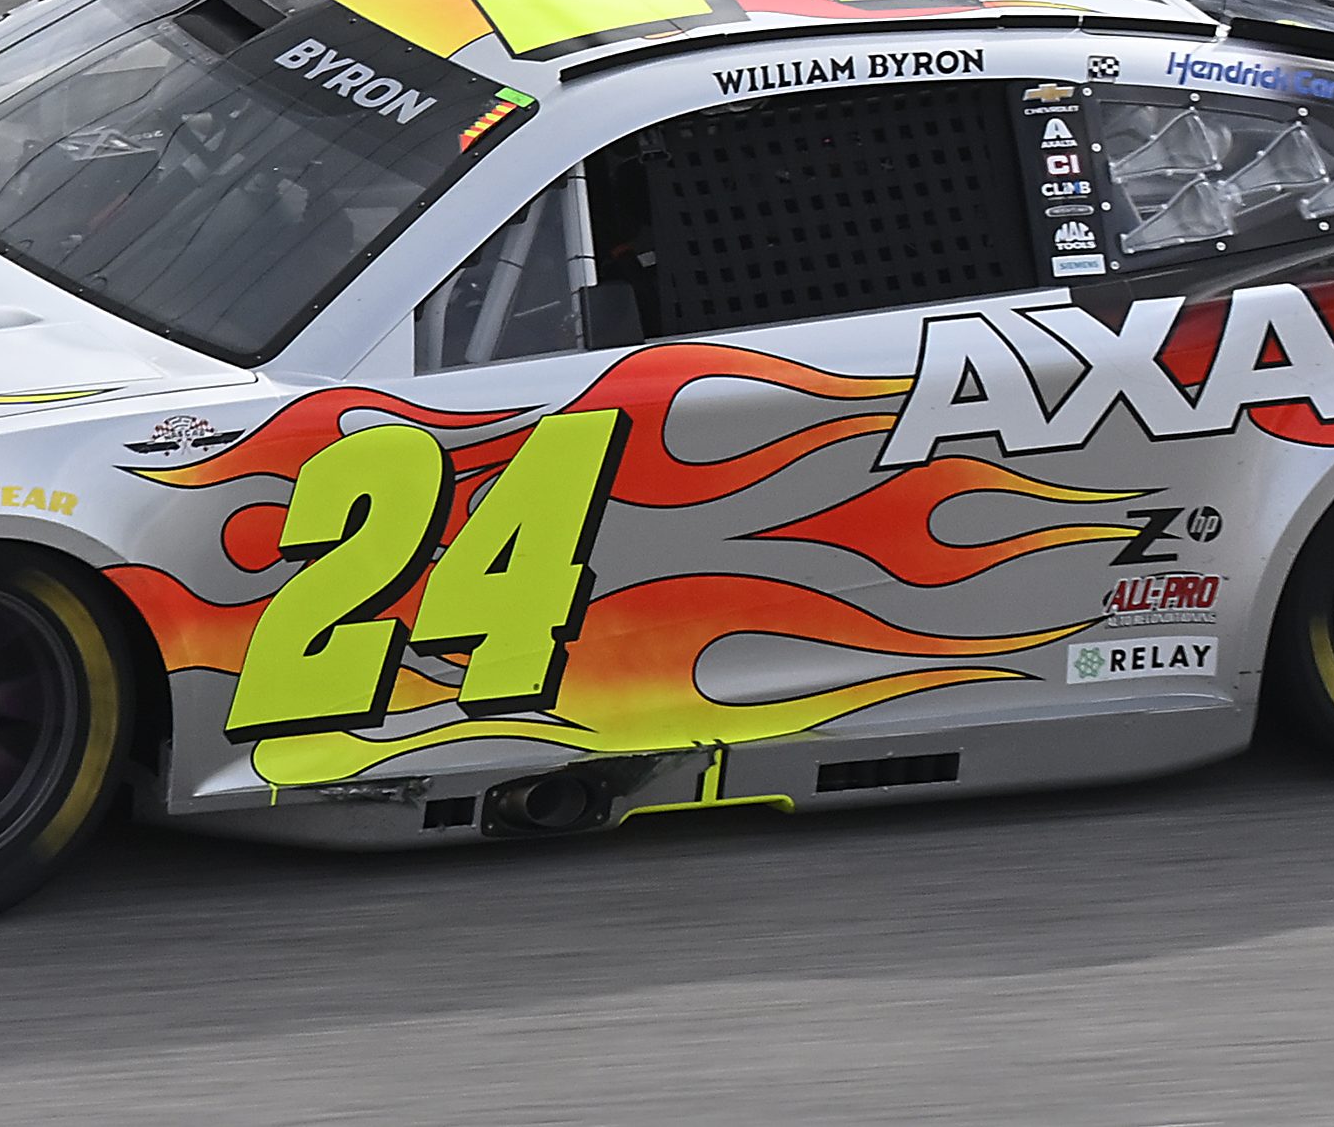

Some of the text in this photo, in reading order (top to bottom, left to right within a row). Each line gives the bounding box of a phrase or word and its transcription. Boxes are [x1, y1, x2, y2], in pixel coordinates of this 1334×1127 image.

[273, 37, 438, 125] BYRON
[713, 48, 984, 95] WILLIAM BYRON
[1054, 221, 1095, 243] MAC
[1056, 241, 1097, 250] TOOLS
[224, 408, 633, 744] 24
[1105, 575, 1220, 614] ALL-PRO
[1109, 645, 1211, 672] RELAY
